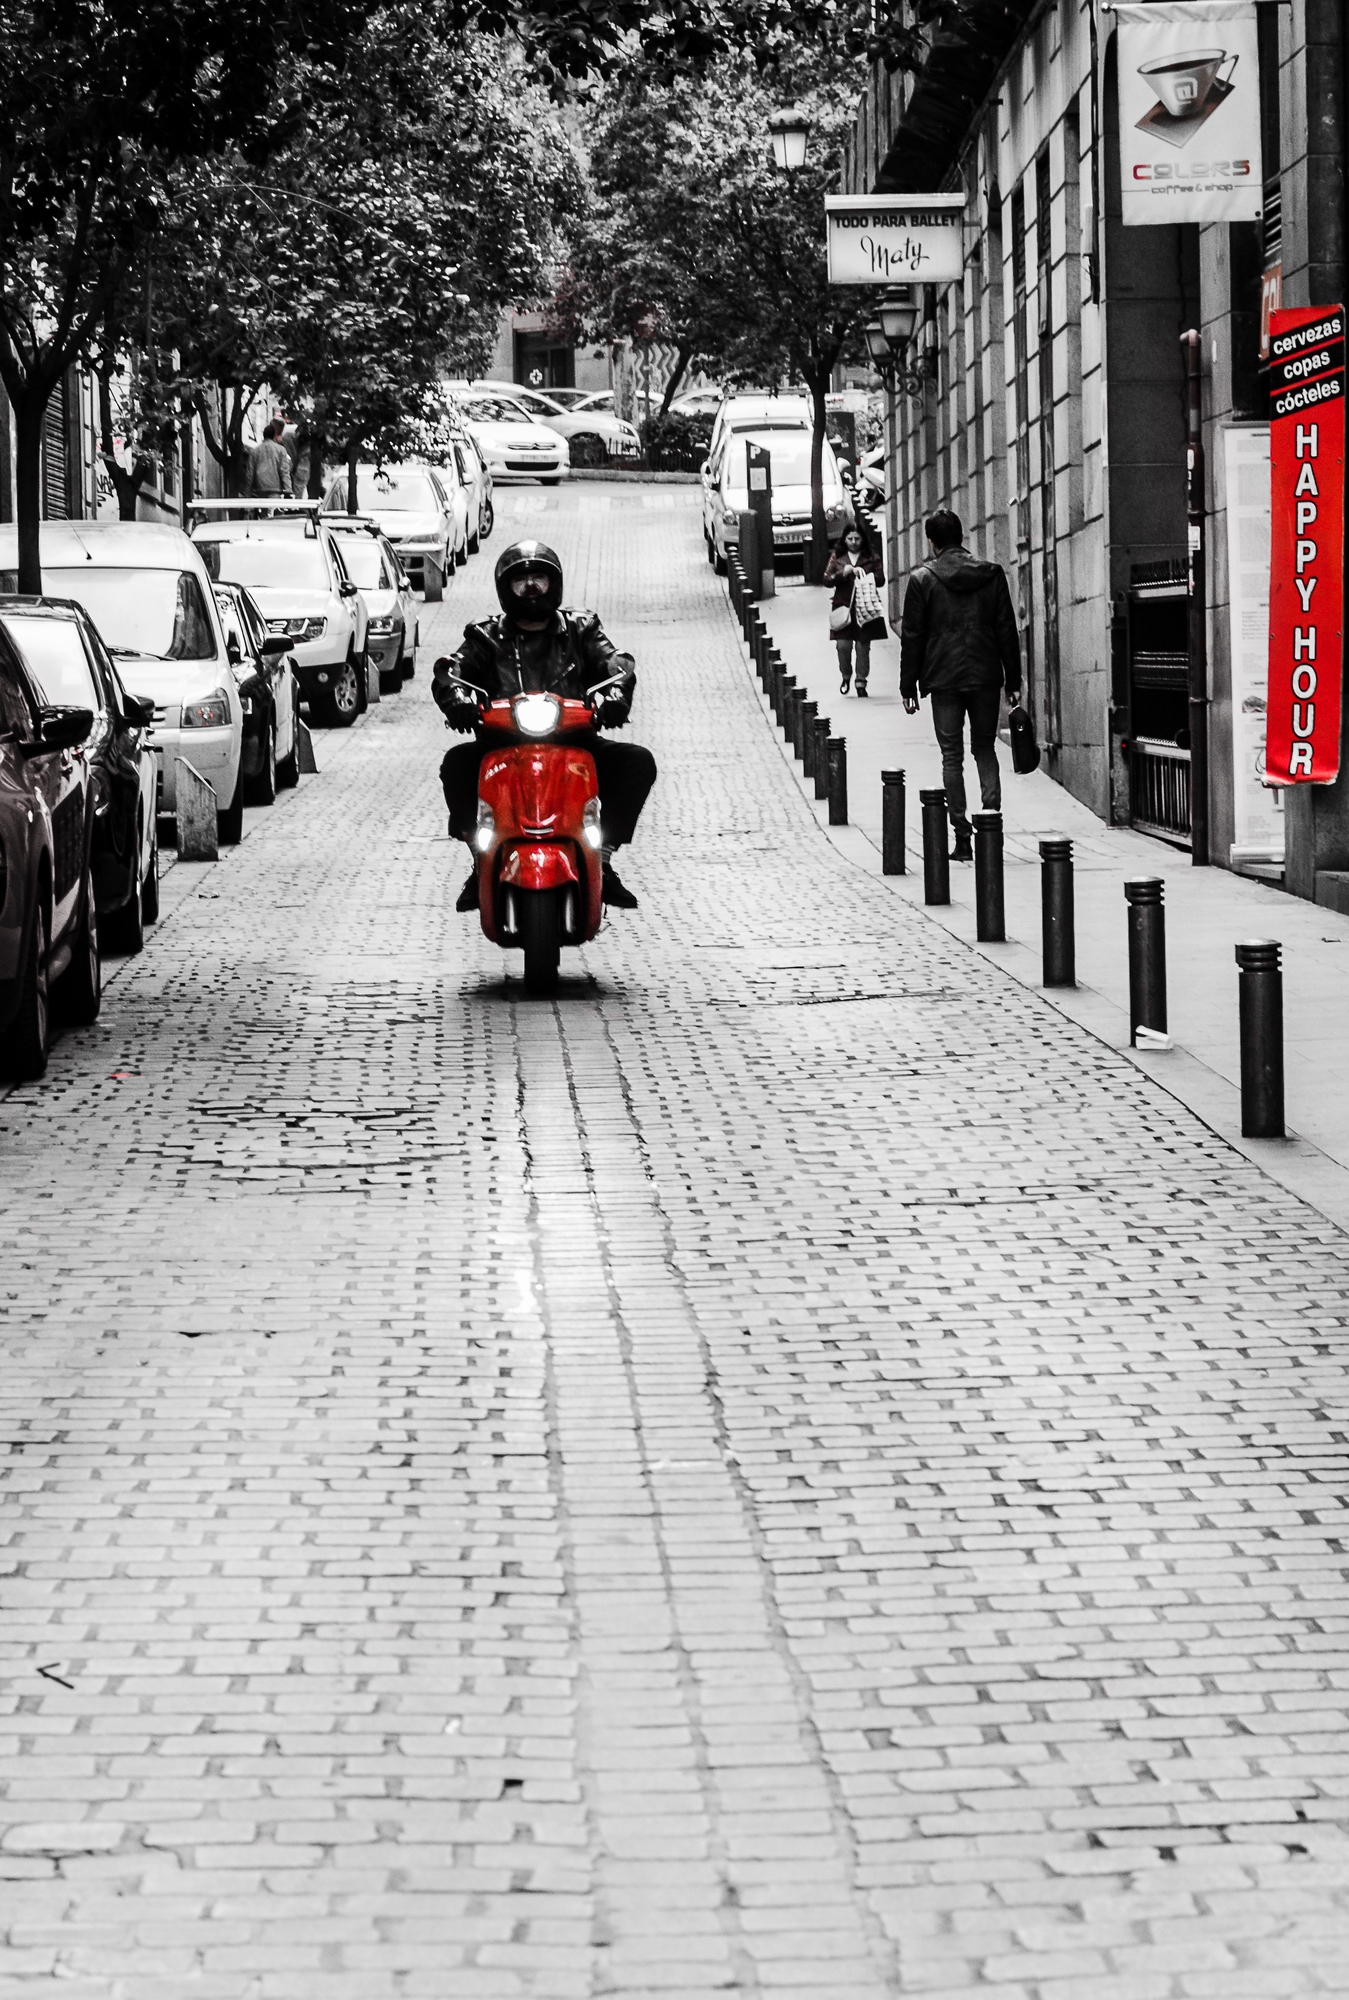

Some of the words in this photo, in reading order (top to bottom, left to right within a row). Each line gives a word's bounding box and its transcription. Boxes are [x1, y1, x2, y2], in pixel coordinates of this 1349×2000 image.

[1132, 160, 1250, 180] COLORS
[1152, 185, 1193, 194] coffee
[1195, 183, 1202, 192] &
[1205, 183, 1233, 192] shop
[834, 216, 869, 228] TODO
[872, 215, 907, 228] PARA
[910, 214, 957, 228] BALLET
[860, 235, 930, 277] Maty
[1273, 318, 1342, 355] cervezas
[1283, 351, 1331, 379] copas
[1275, 380, 1341, 414] cócteles
[750, 445, 762, 460] P
[1294, 423, 1319, 612] HAPPY
[1288, 626, 1318, 776] HOUR
